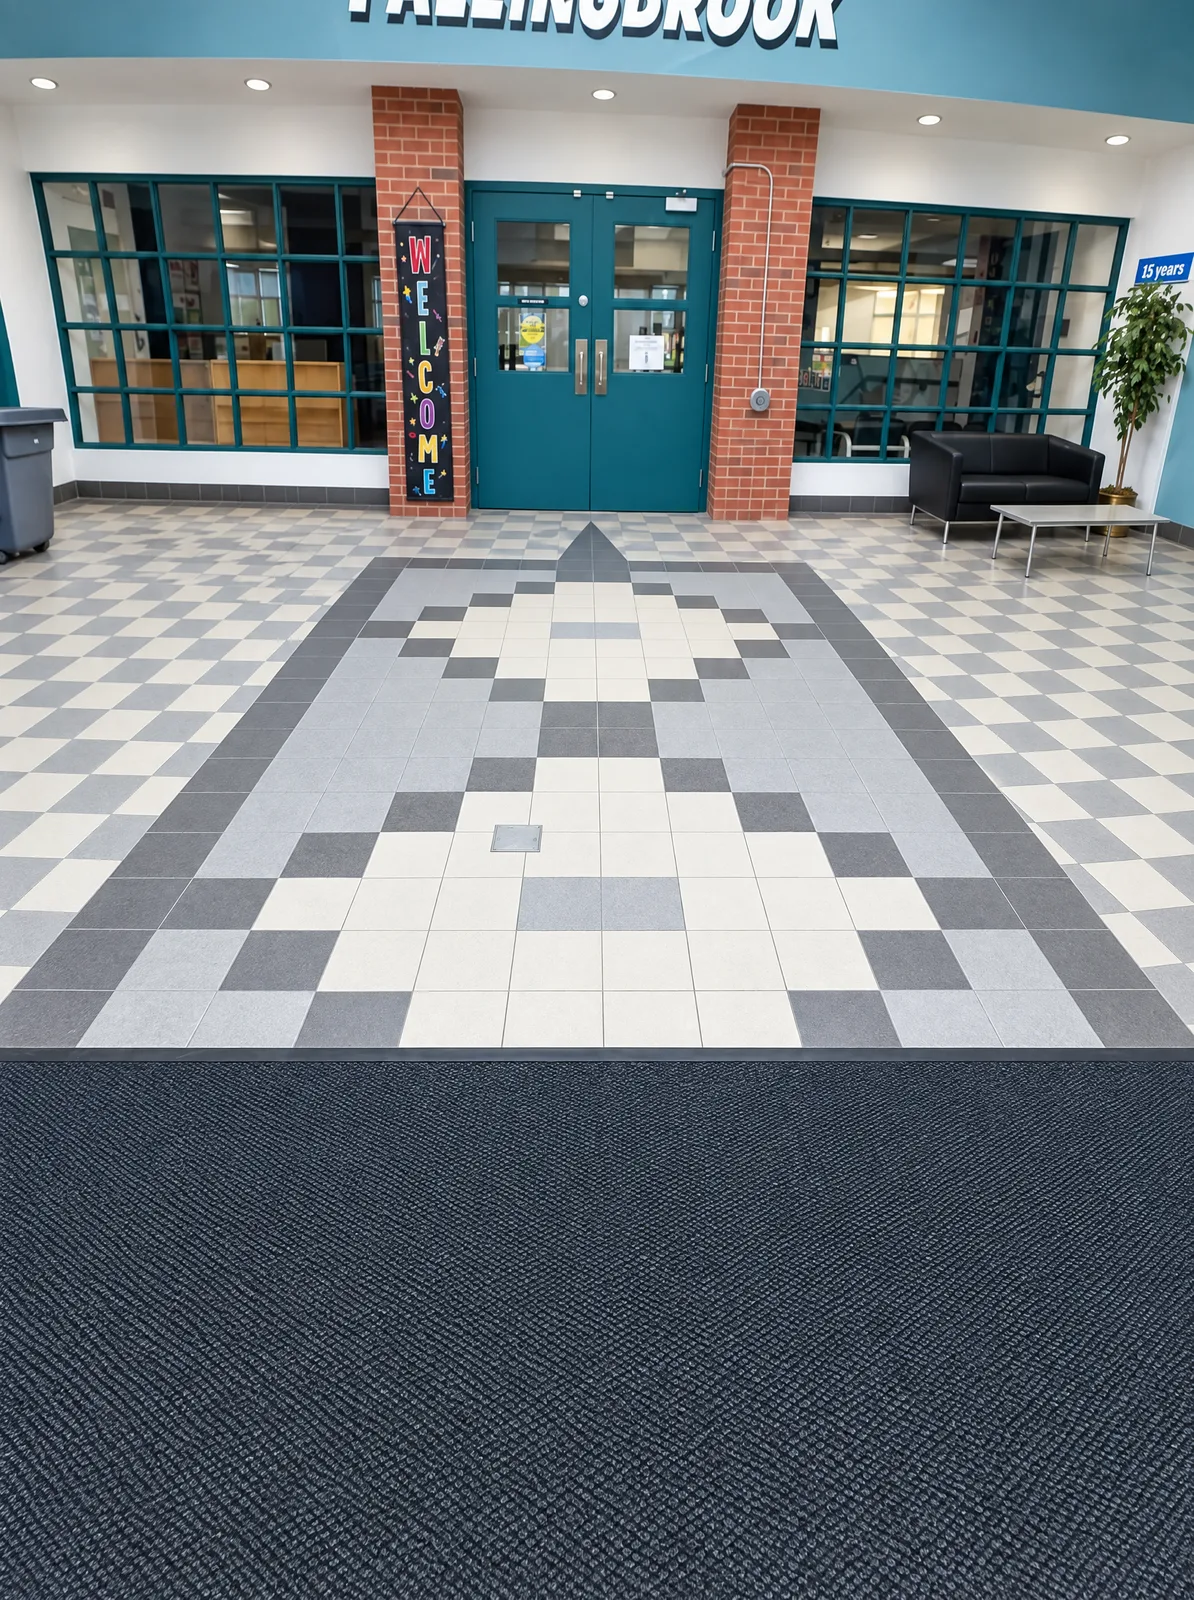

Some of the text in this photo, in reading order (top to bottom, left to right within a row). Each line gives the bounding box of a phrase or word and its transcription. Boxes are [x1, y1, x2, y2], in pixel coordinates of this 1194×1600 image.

[1141, 263, 1185, 281] 15 years
[408, 235, 439, 495] WELCOME
